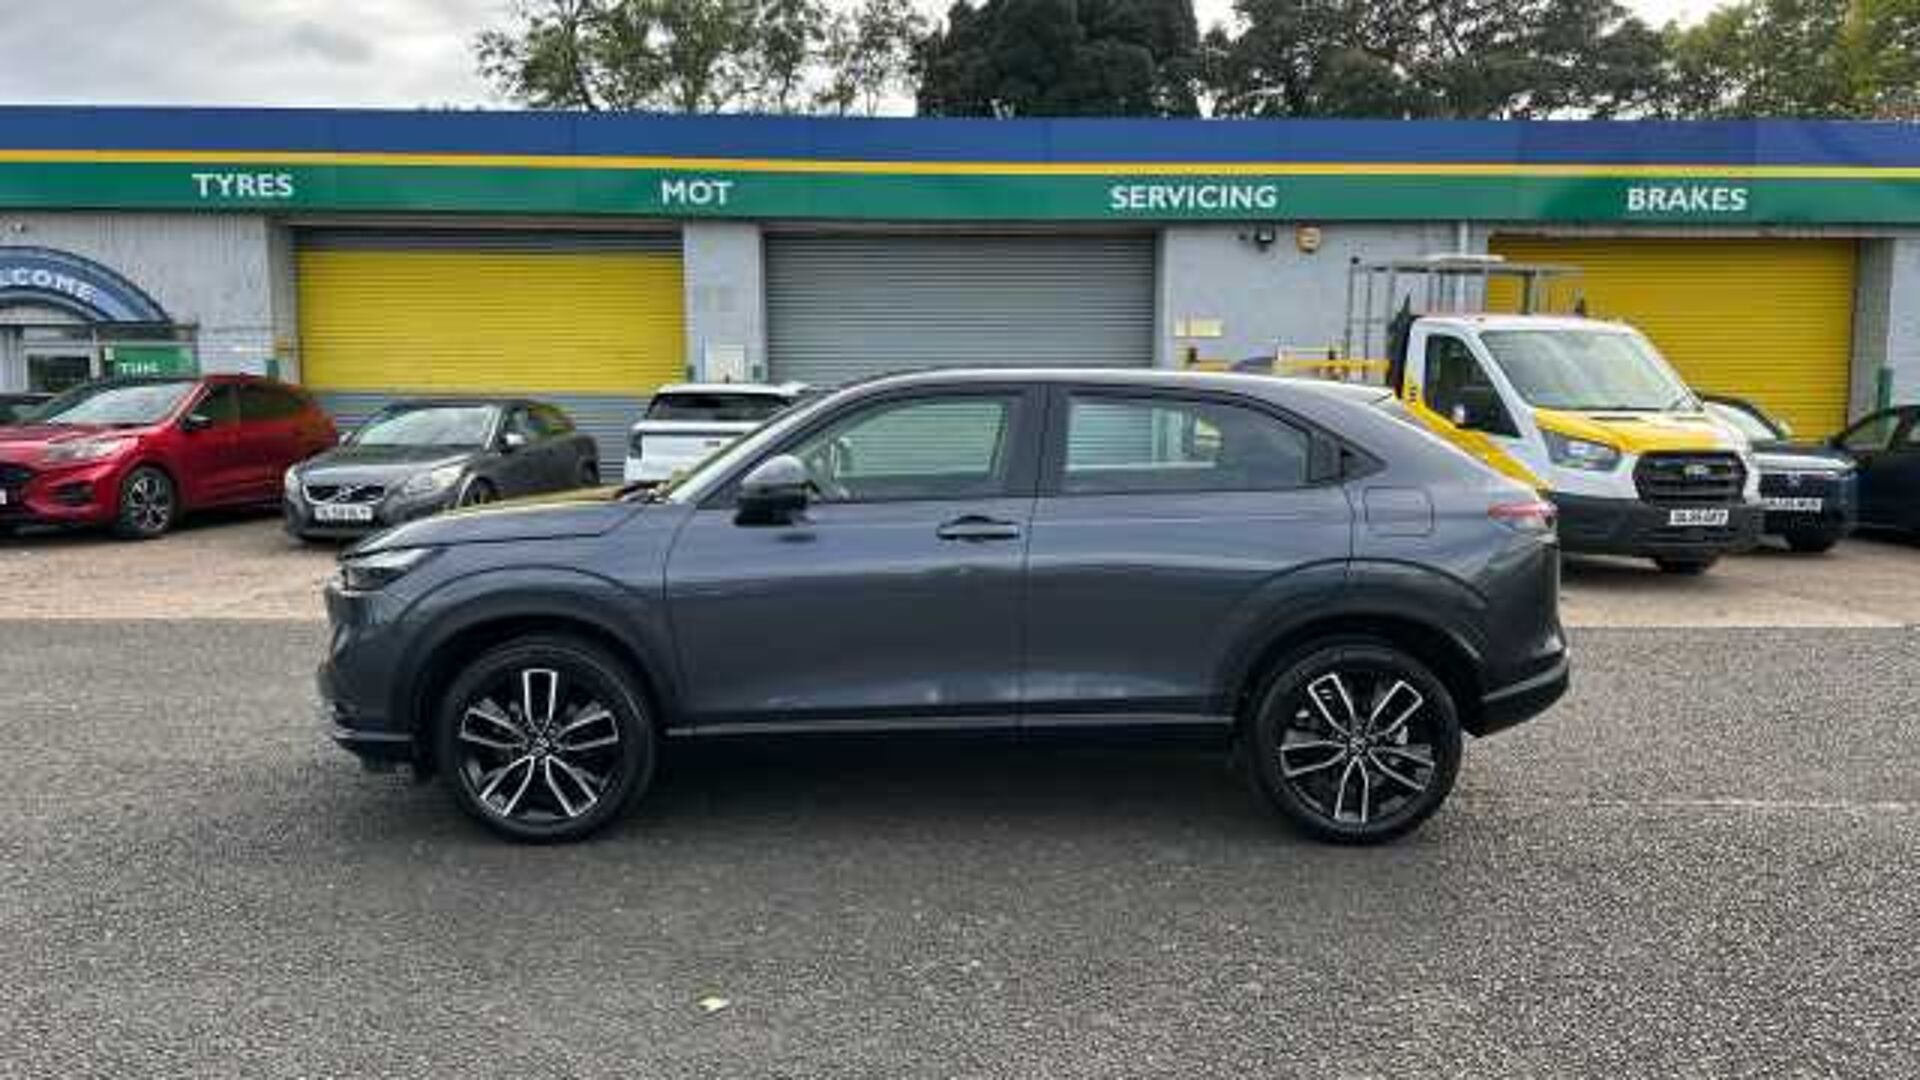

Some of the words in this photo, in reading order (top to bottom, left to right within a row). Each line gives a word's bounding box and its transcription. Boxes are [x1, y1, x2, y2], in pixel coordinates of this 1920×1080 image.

[191, 172, 294, 197] TYRES
[660, 179, 733, 205] MOT
[1110, 184, 1278, 209] SERVICING
[1626, 186, 1747, 212] BRAKES
